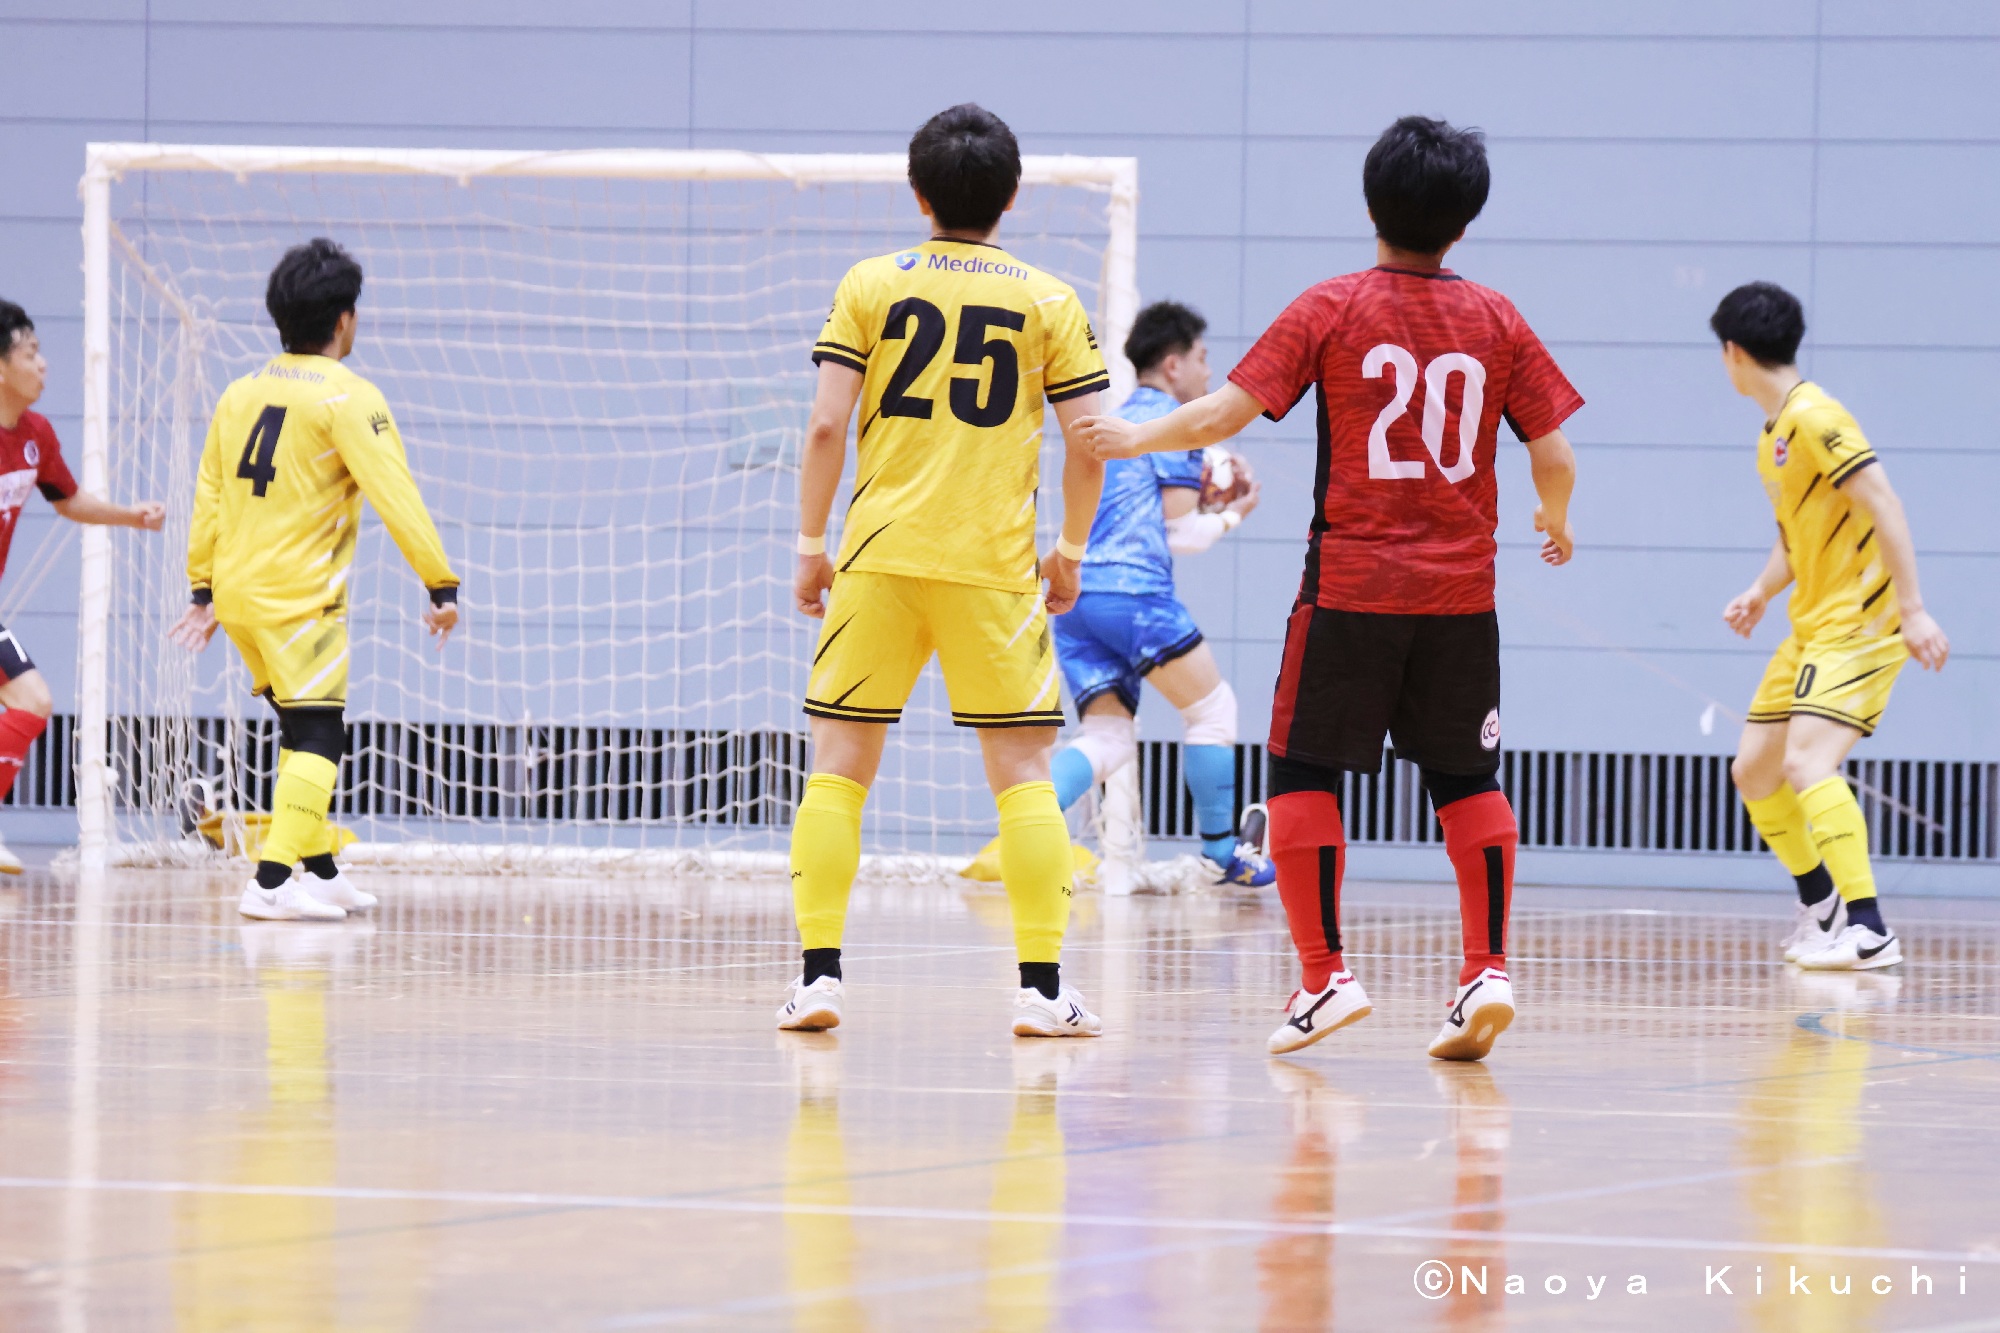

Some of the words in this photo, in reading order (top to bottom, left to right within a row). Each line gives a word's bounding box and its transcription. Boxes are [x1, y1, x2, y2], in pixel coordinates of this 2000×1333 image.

[927, 253, 1028, 281] Medicom
[269, 363, 326, 384] Medicom
[880, 296, 1026, 428] 25
[236, 405, 288, 498] 4
[1362, 344, 1487, 484] 20
